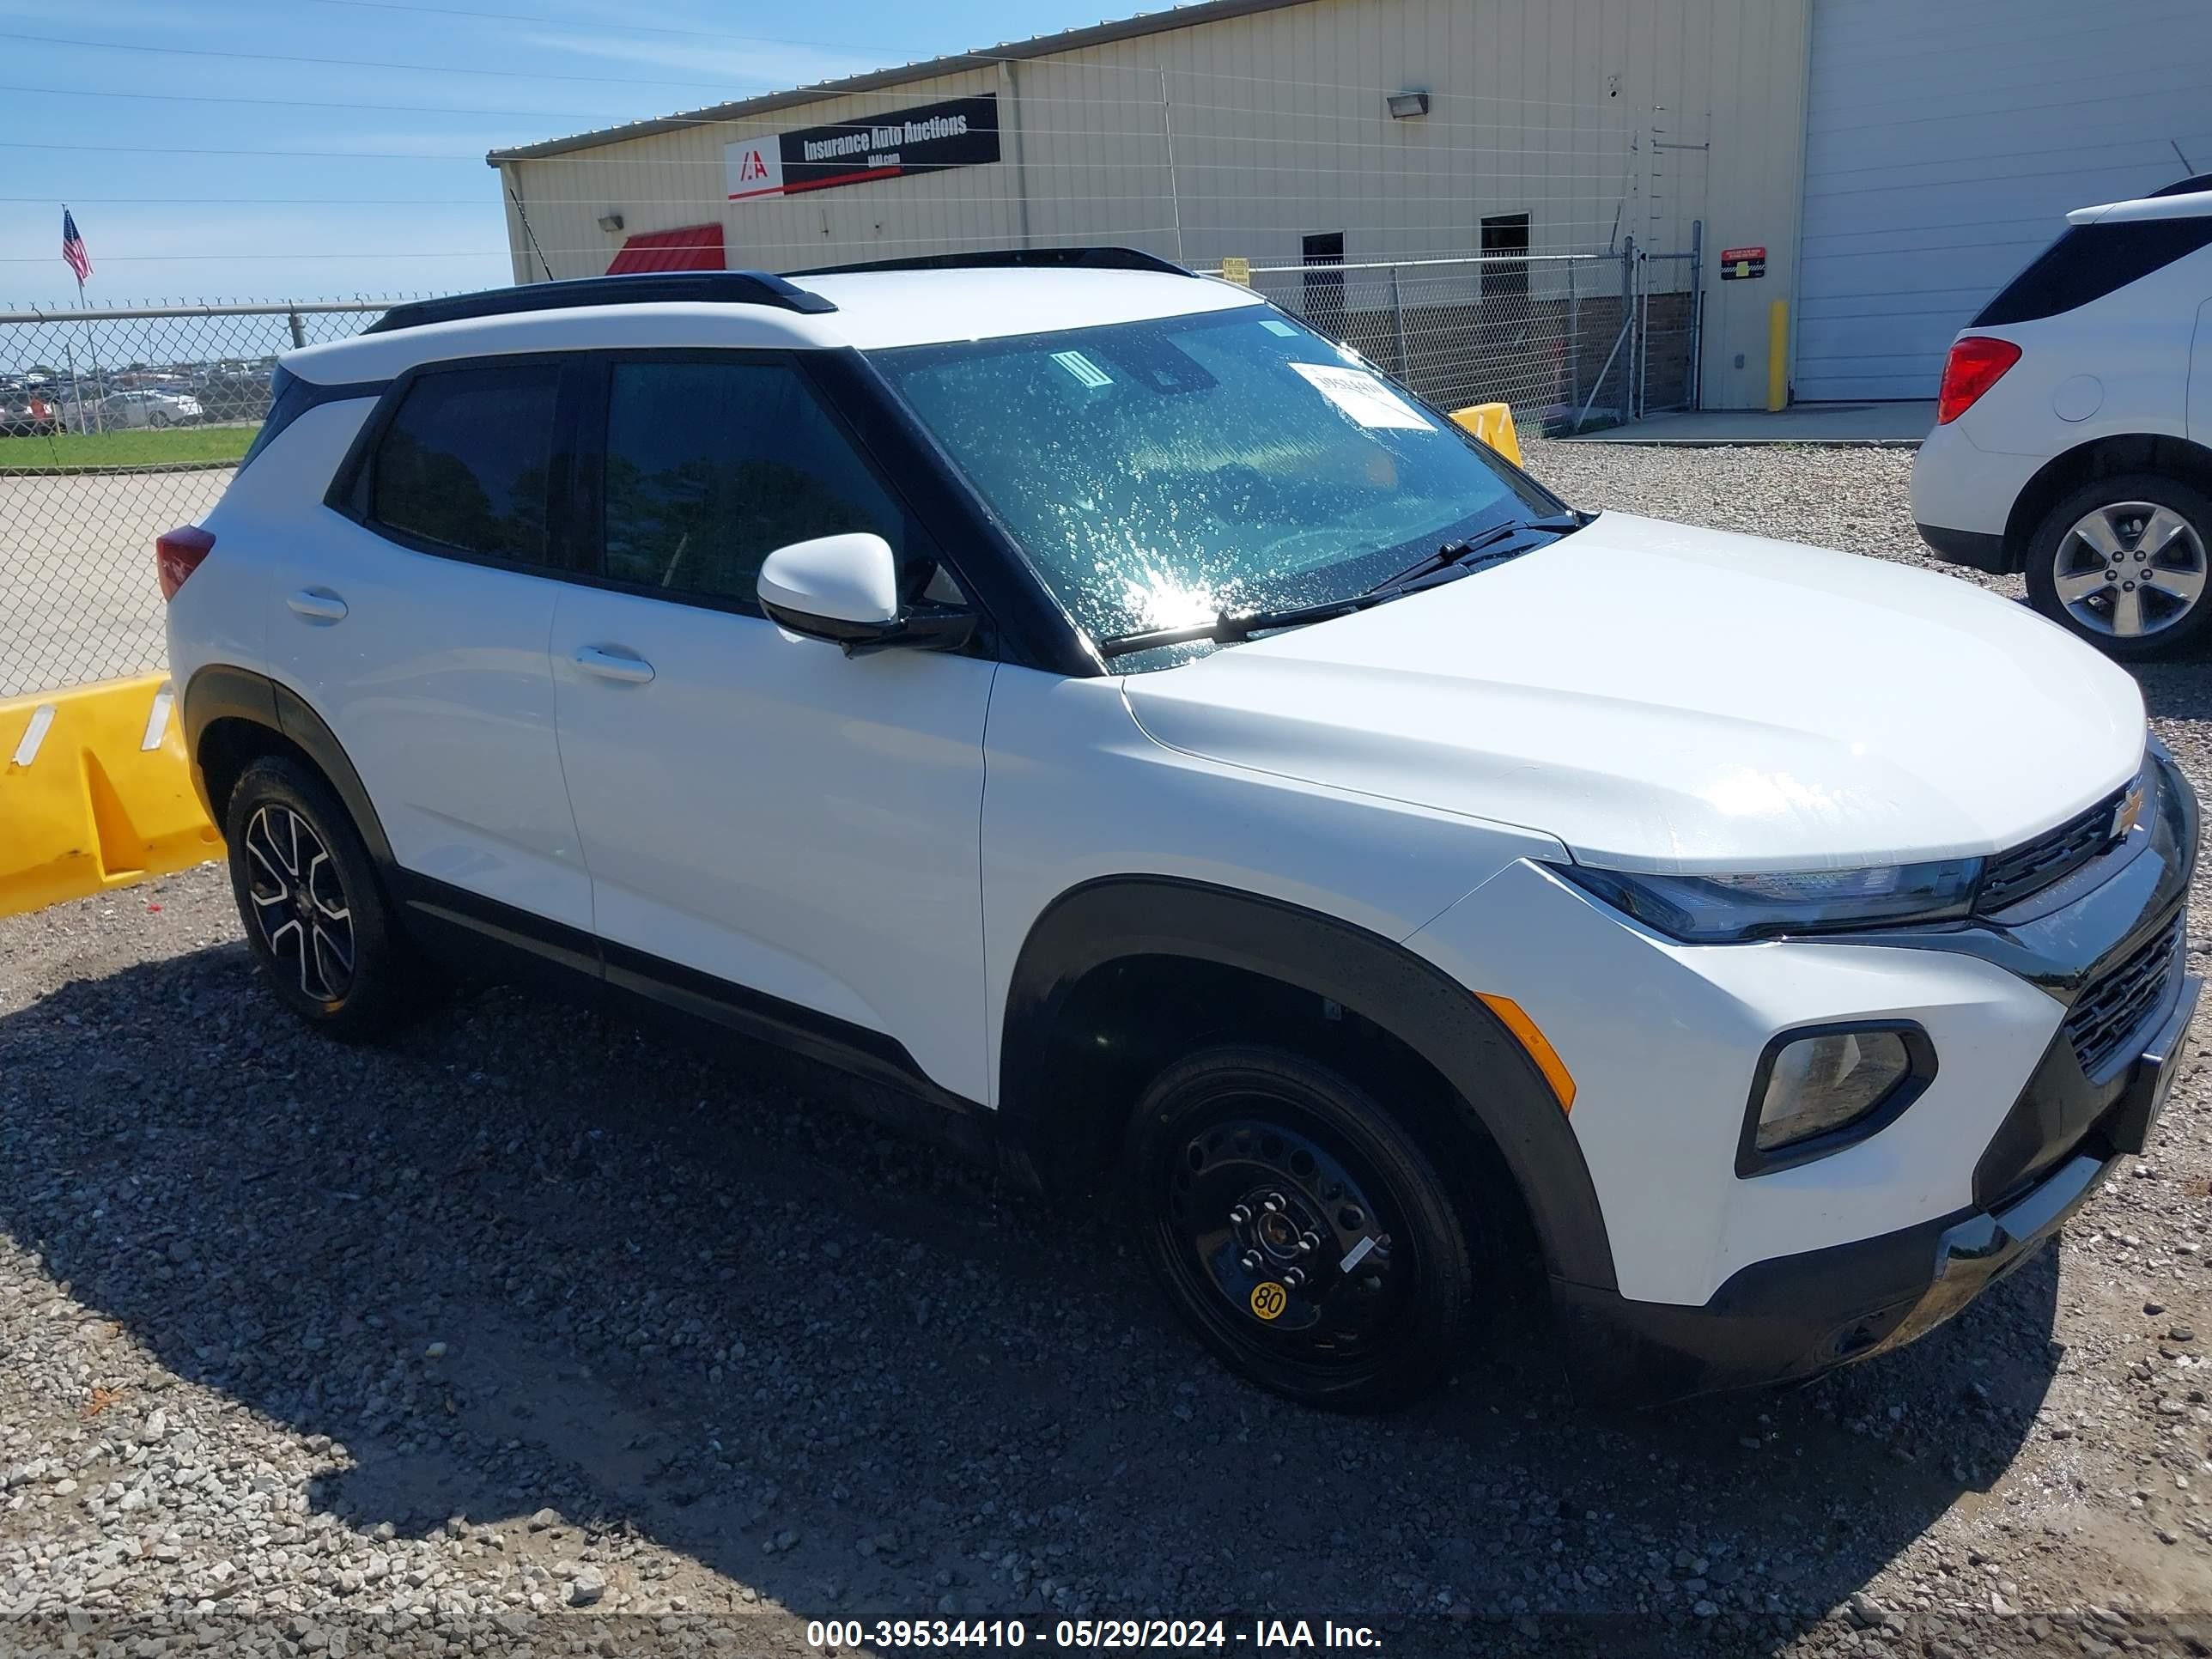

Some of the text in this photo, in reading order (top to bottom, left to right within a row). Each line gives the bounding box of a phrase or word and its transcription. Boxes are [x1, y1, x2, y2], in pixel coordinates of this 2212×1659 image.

[804, 114, 968, 161] Insurance Auto Auctions
[1255, 1287, 1283, 1314] 80
